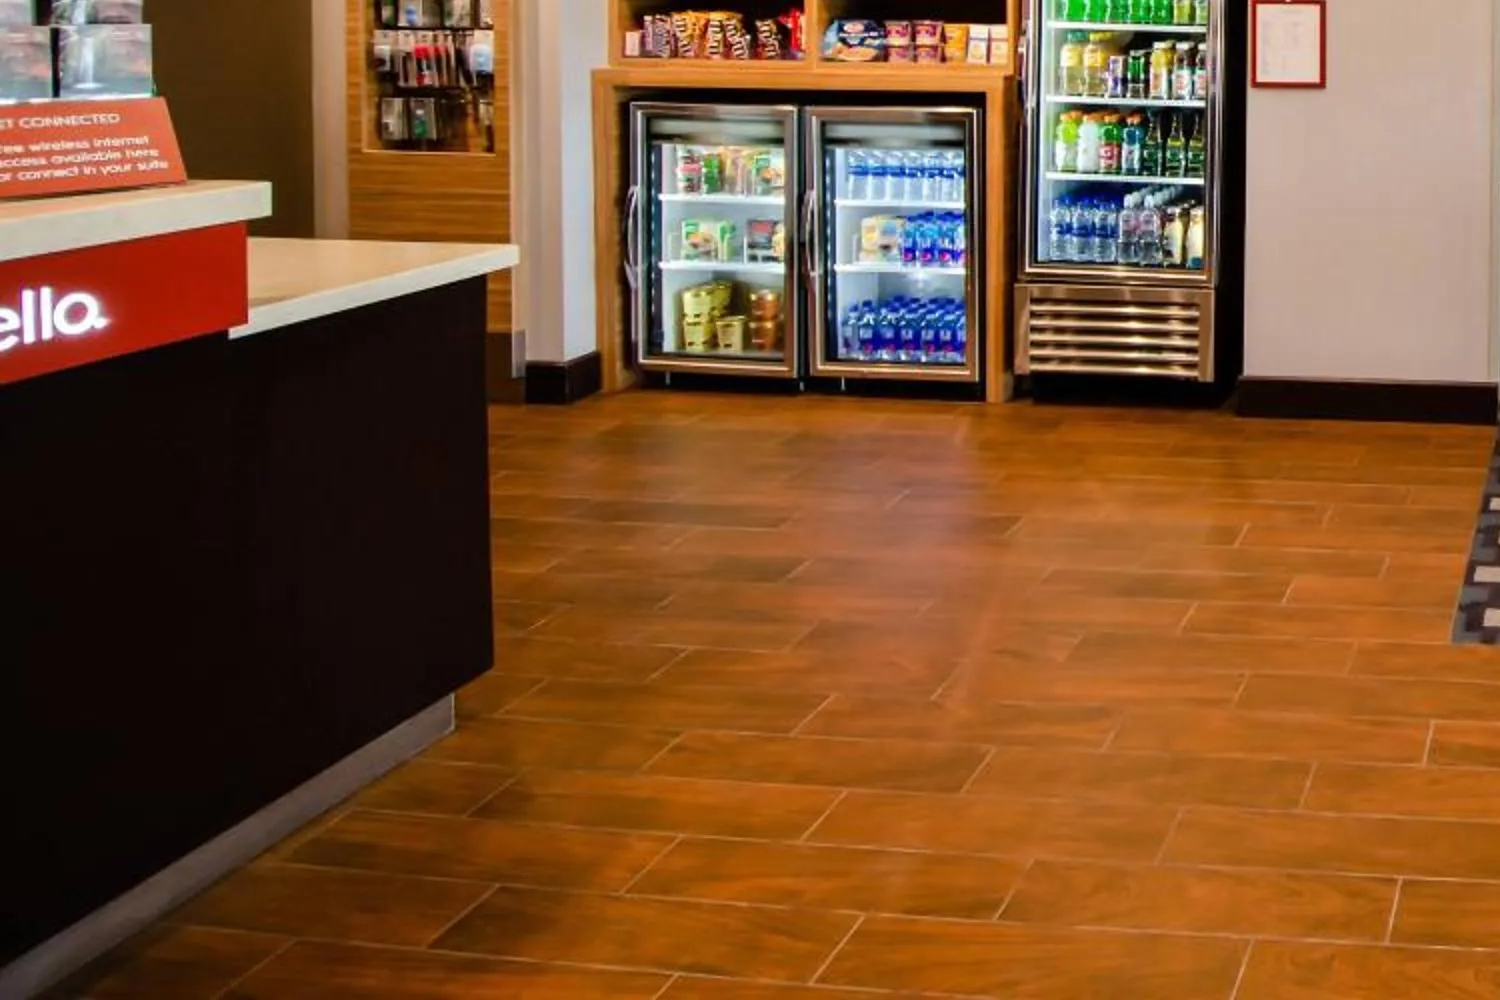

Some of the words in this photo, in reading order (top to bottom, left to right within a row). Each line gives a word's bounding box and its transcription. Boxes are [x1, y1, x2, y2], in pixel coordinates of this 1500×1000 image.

[19, 113, 120, 129] CONNECTED
[28, 140, 90, 152] wireless
[93, 135, 149, 148] internet
[50, 150, 121, 165] available
[125, 148, 159, 159] here
[17, 167, 79, 181] connect
[82, 165, 98, 176] in
[100, 163, 132, 177] your
[136, 160, 169, 171] suite
